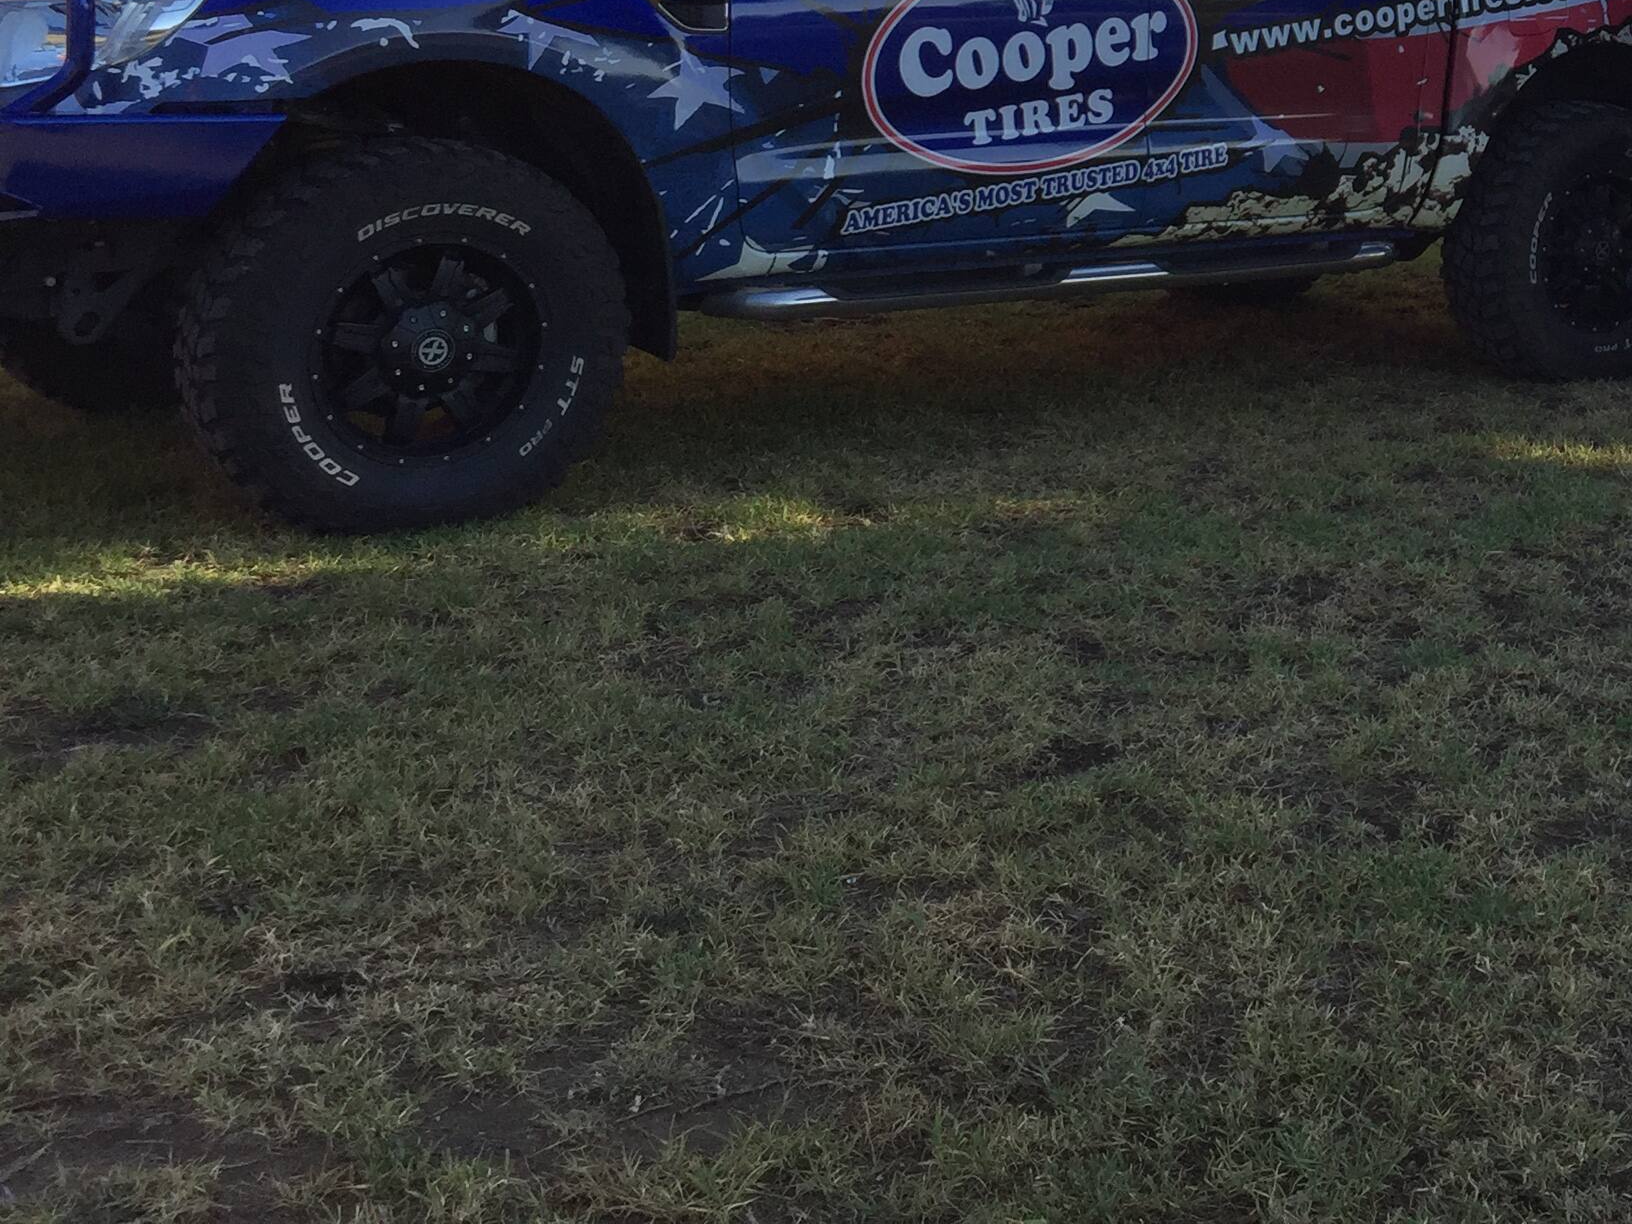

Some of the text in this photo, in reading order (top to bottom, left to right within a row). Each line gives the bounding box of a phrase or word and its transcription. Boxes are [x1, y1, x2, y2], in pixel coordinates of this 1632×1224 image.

[899, 9, 1169, 99] Cooper
[964, 88, 1114, 145] TIRES
[356, 202, 532, 243] DISCOVERER
[840, 140, 1230, 235] AMERICA'S MOST TRUSTED 4x4 TIRE
[278, 382, 361, 488] COOPER
[518, 354, 586, 458] STT PRO
